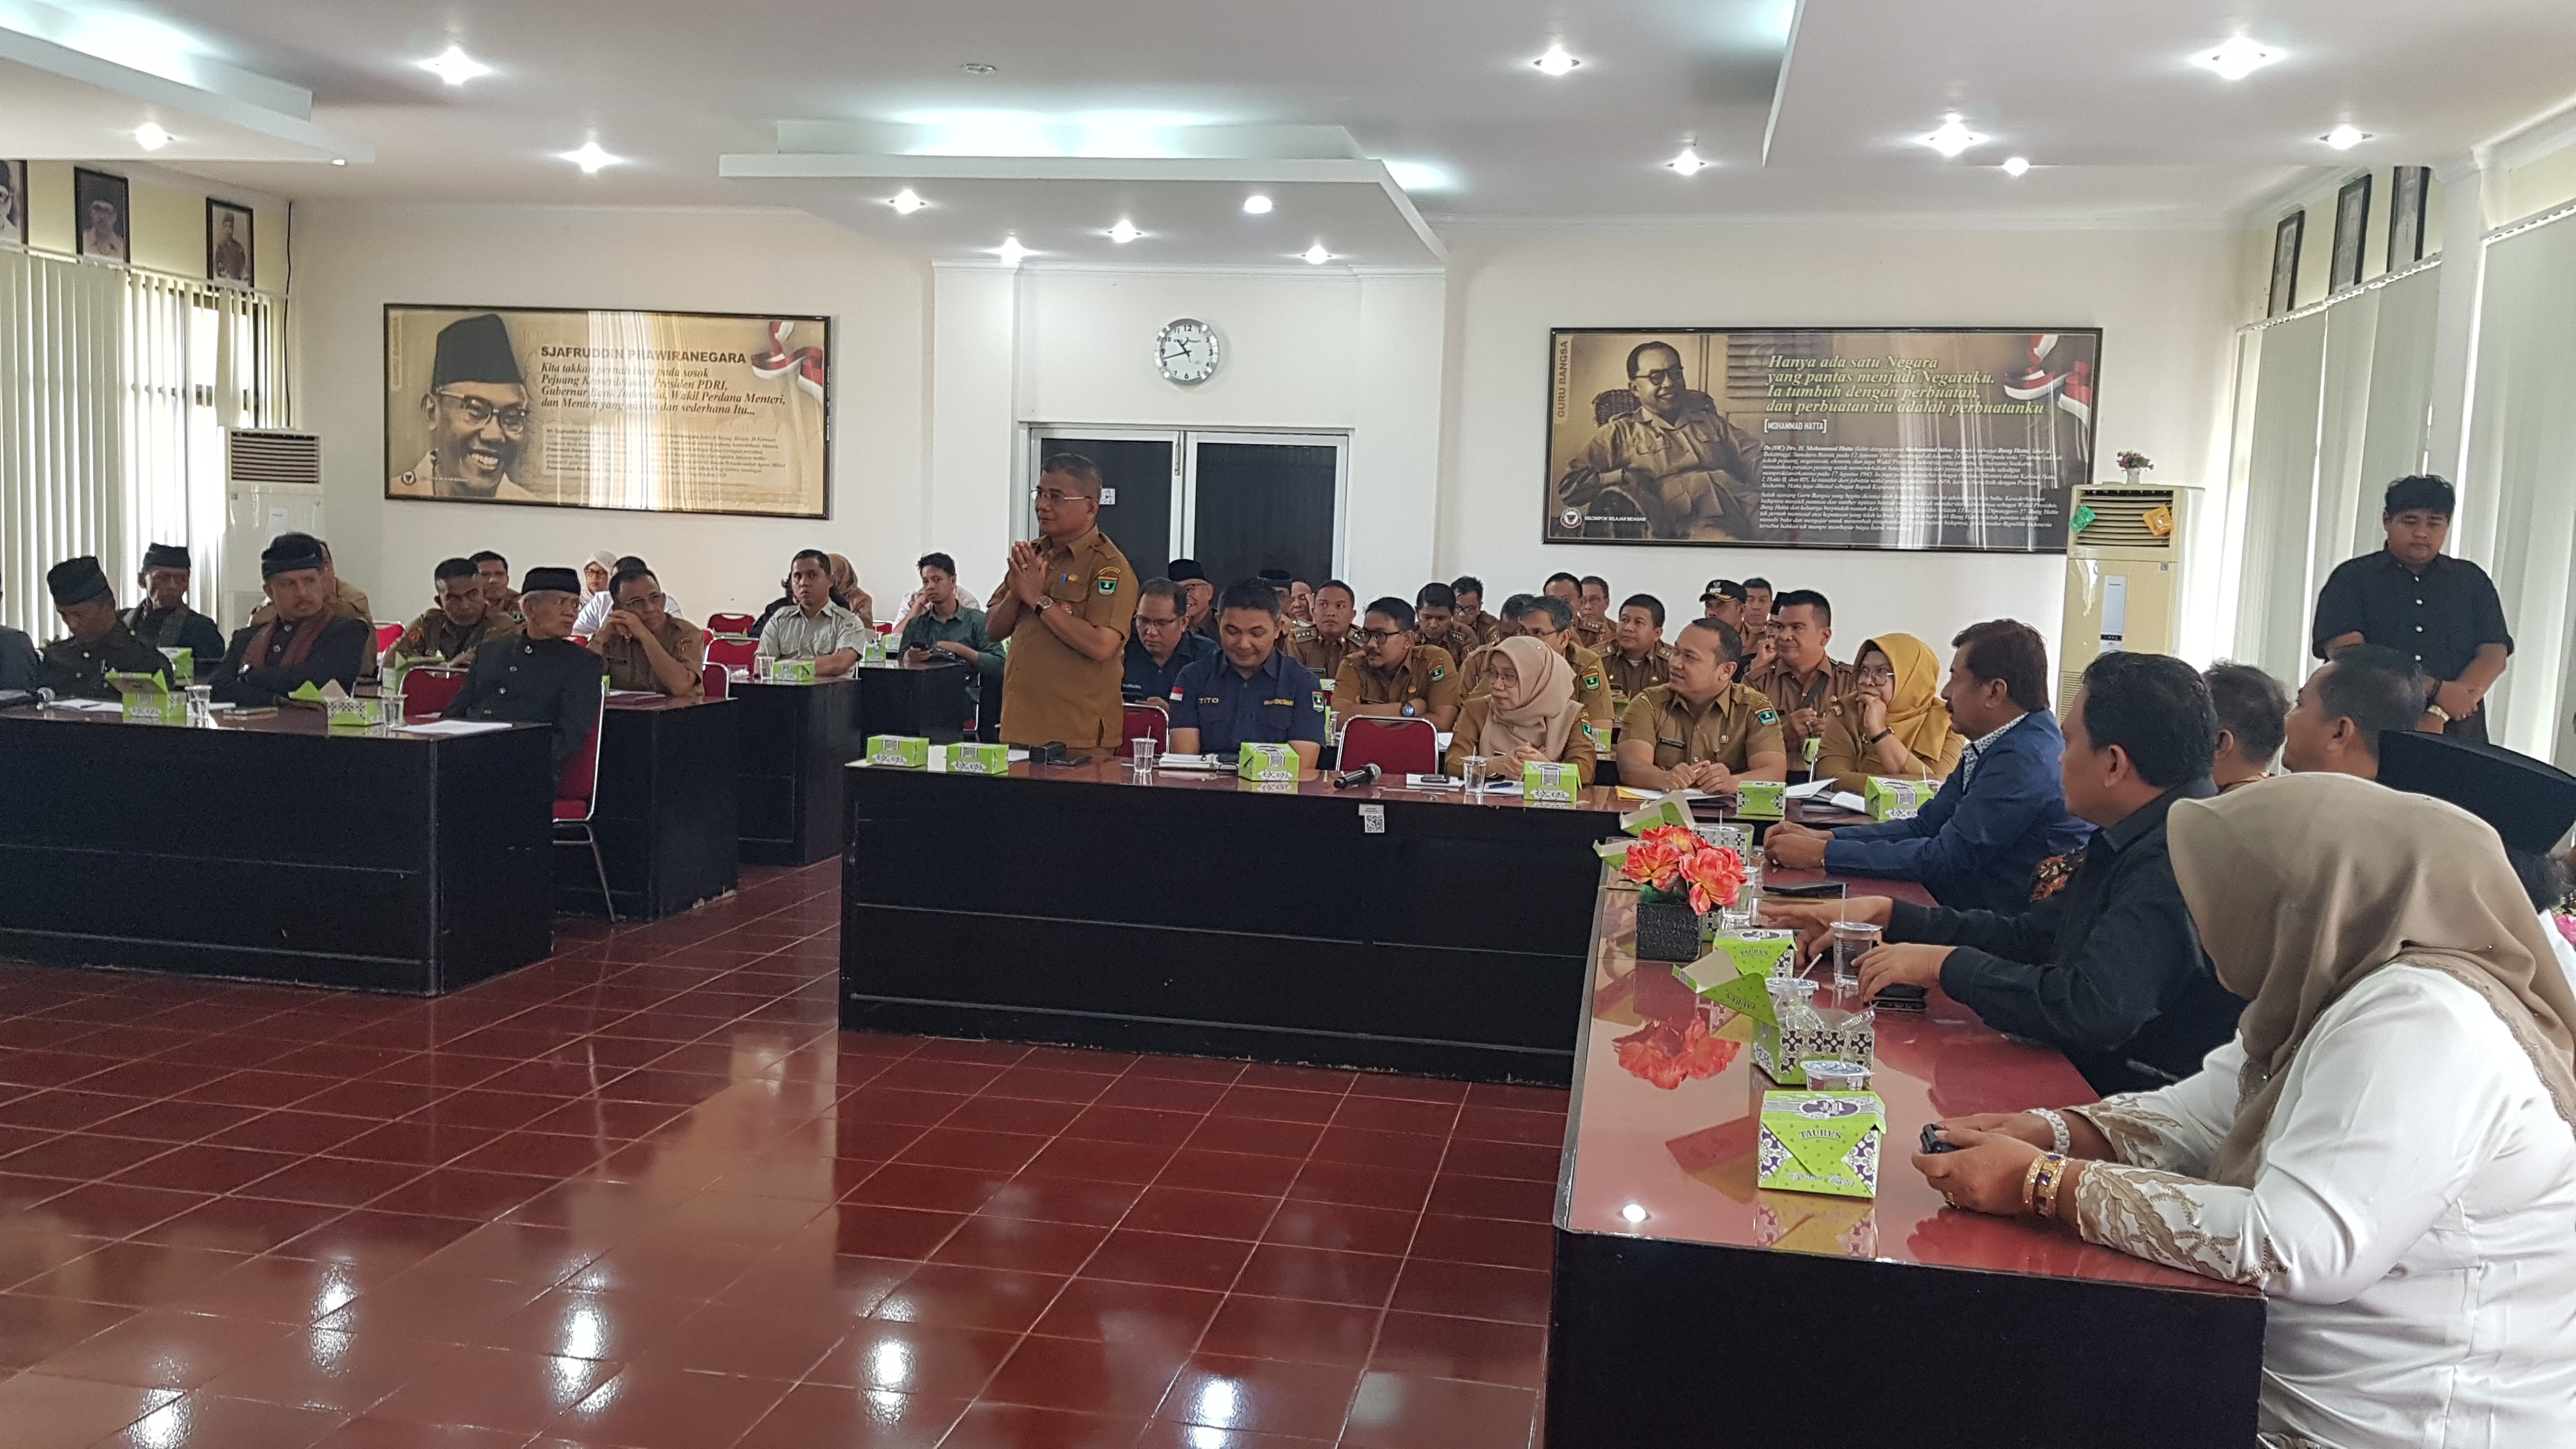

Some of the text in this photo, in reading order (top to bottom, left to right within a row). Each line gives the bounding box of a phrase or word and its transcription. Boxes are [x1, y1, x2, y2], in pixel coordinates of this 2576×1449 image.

[540, 346, 624, 358] SJAFRUDDIN
[540, 362, 560, 373] Kita
[562, 364, 594, 374] takkan
[683, 367, 709, 378] sosok
[1768, 355, 1938, 371] Hanya ada satu Negara
[541, 374, 579, 387] Pejuang
[697, 380, 728, 391] PDRI,
[1765, 370, 1995, 387] yang pantas menjadi Negaraku.
[541, 386, 588, 397] Gubernur
[671, 390, 700, 401] Wakil
[703, 392, 742, 402] Perdana
[744, 394, 786, 406] Menteri,
[1767, 385, 1981, 401] Ia tumbuh dengan perbuatan,
[541, 397, 559, 407] dan
[562, 398, 598, 410] Menteri
[600, 402, 624, 412] yang
[660, 402, 678, 412] dan
[682, 402, 730, 413] sederhana
[1766, 399, 2044, 417] dan perbuatan itu adalah perbuatanku
[1798, 1129, 1843, 1140] TAURUS
